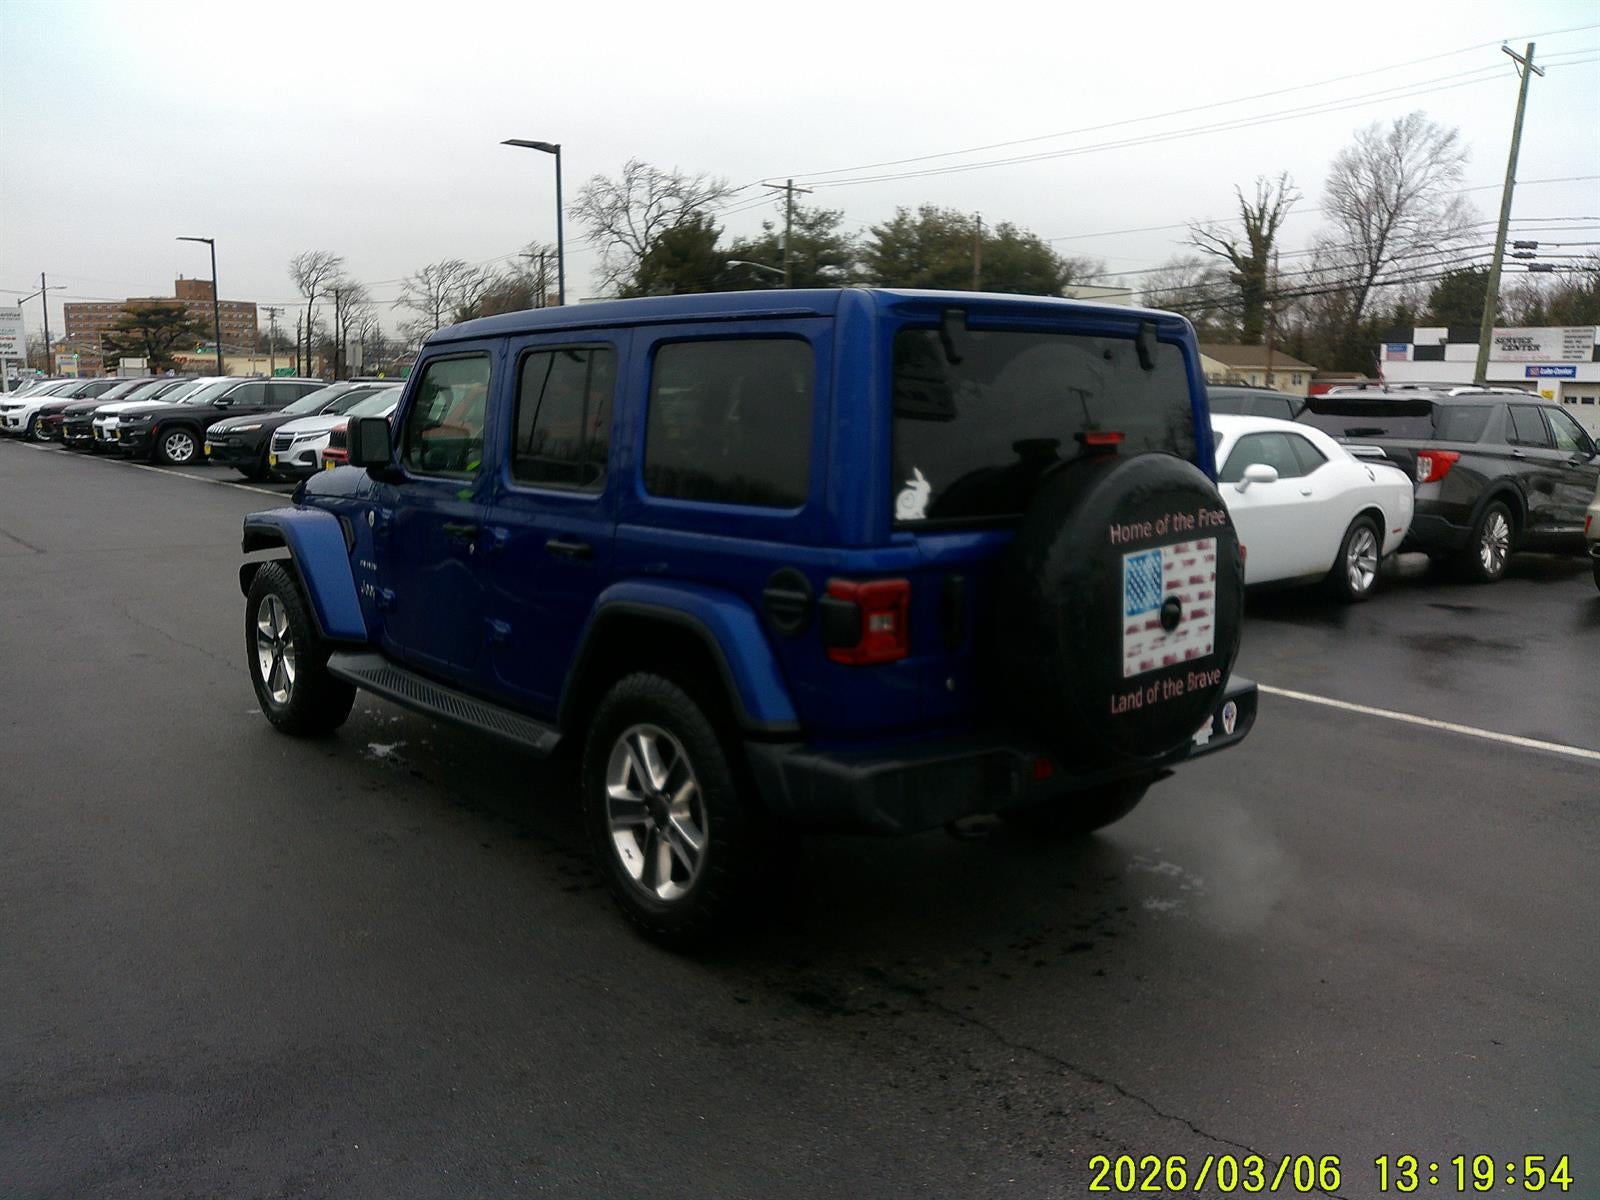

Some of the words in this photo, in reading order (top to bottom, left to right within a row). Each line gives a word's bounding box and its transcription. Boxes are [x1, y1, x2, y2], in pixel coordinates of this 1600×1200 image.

[1110, 521, 1152, 545] Home
[1156, 513, 1170, 536] of
[1173, 511, 1194, 532] the
[1198, 508, 1225, 528] Free
[1111, 686, 1143, 714] Land
[1146, 681, 1160, 705] of
[1163, 677, 1184, 700] the
[1187, 668, 1221, 692] Brave
